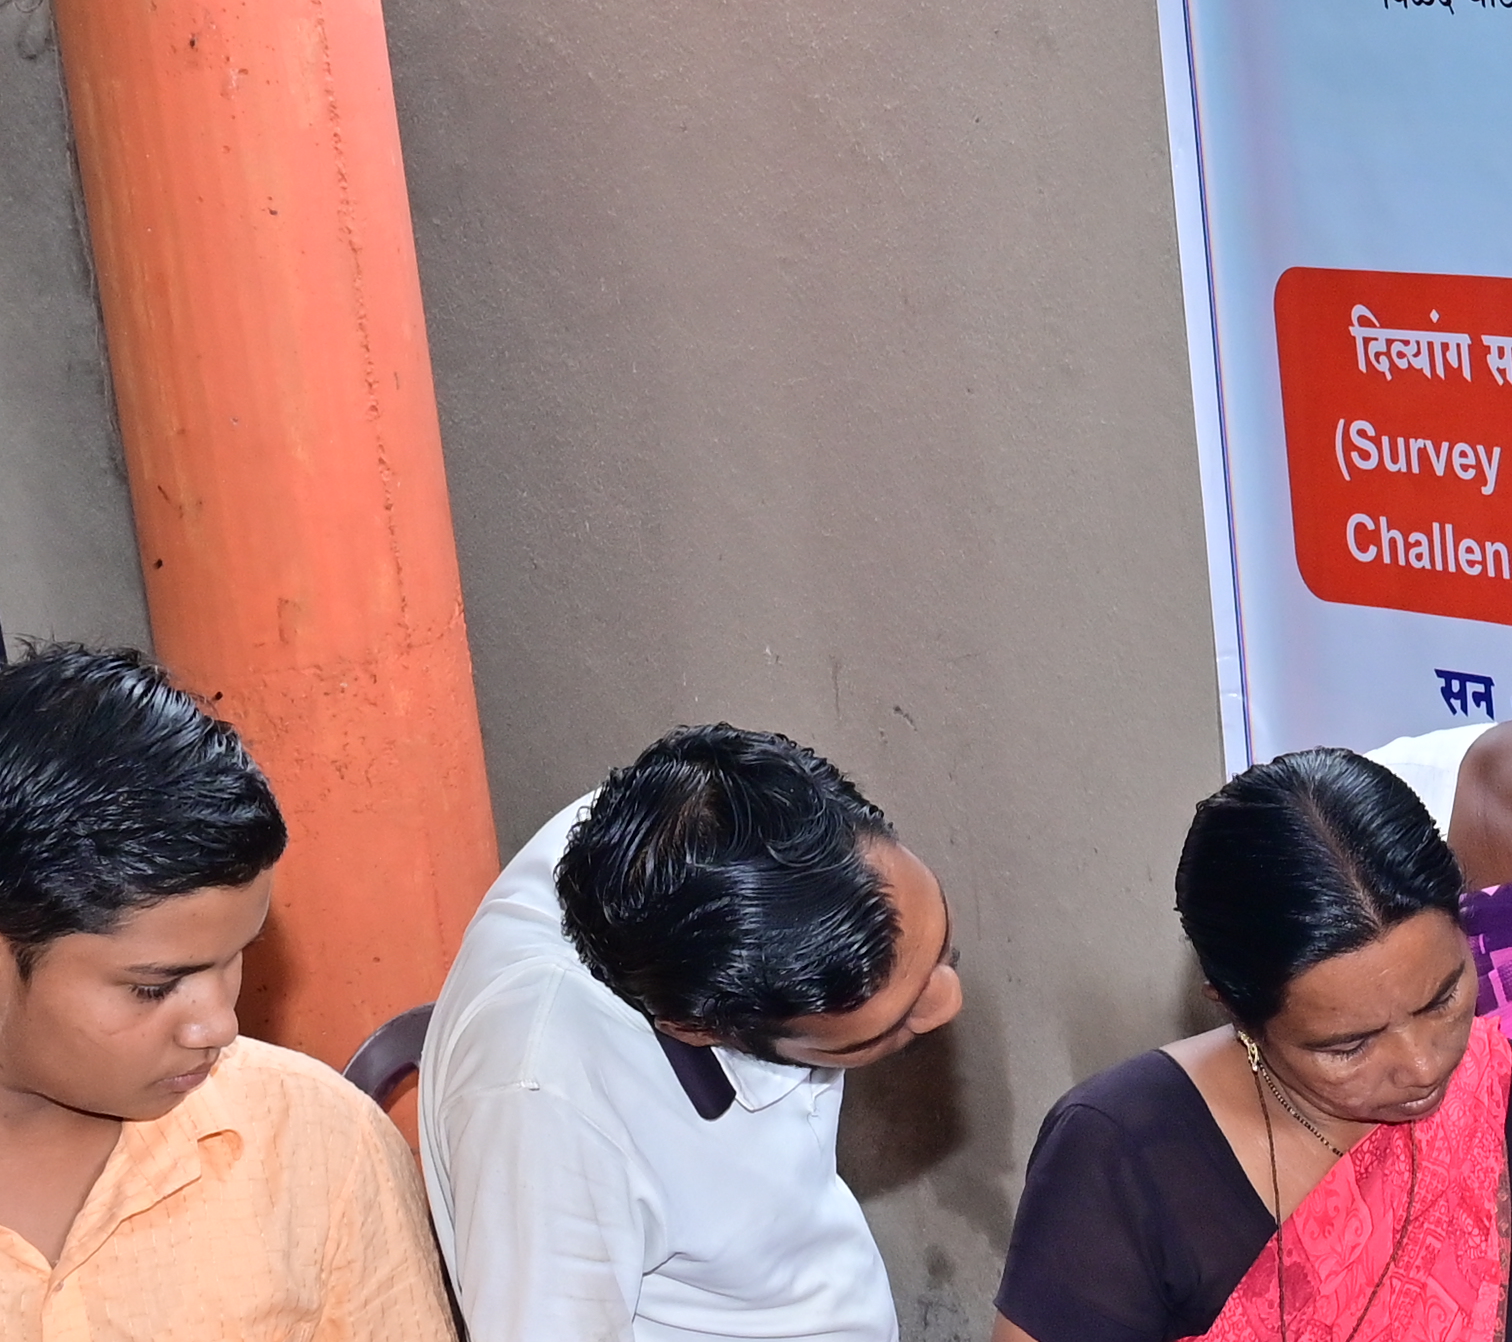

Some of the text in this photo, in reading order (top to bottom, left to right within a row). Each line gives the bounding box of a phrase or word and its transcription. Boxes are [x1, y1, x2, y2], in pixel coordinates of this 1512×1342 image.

[1348, 304, 1473, 384] दिव्यांग
[1334, 416, 1502, 496] (Survey
[1433, 668, 1496, 719] सन
